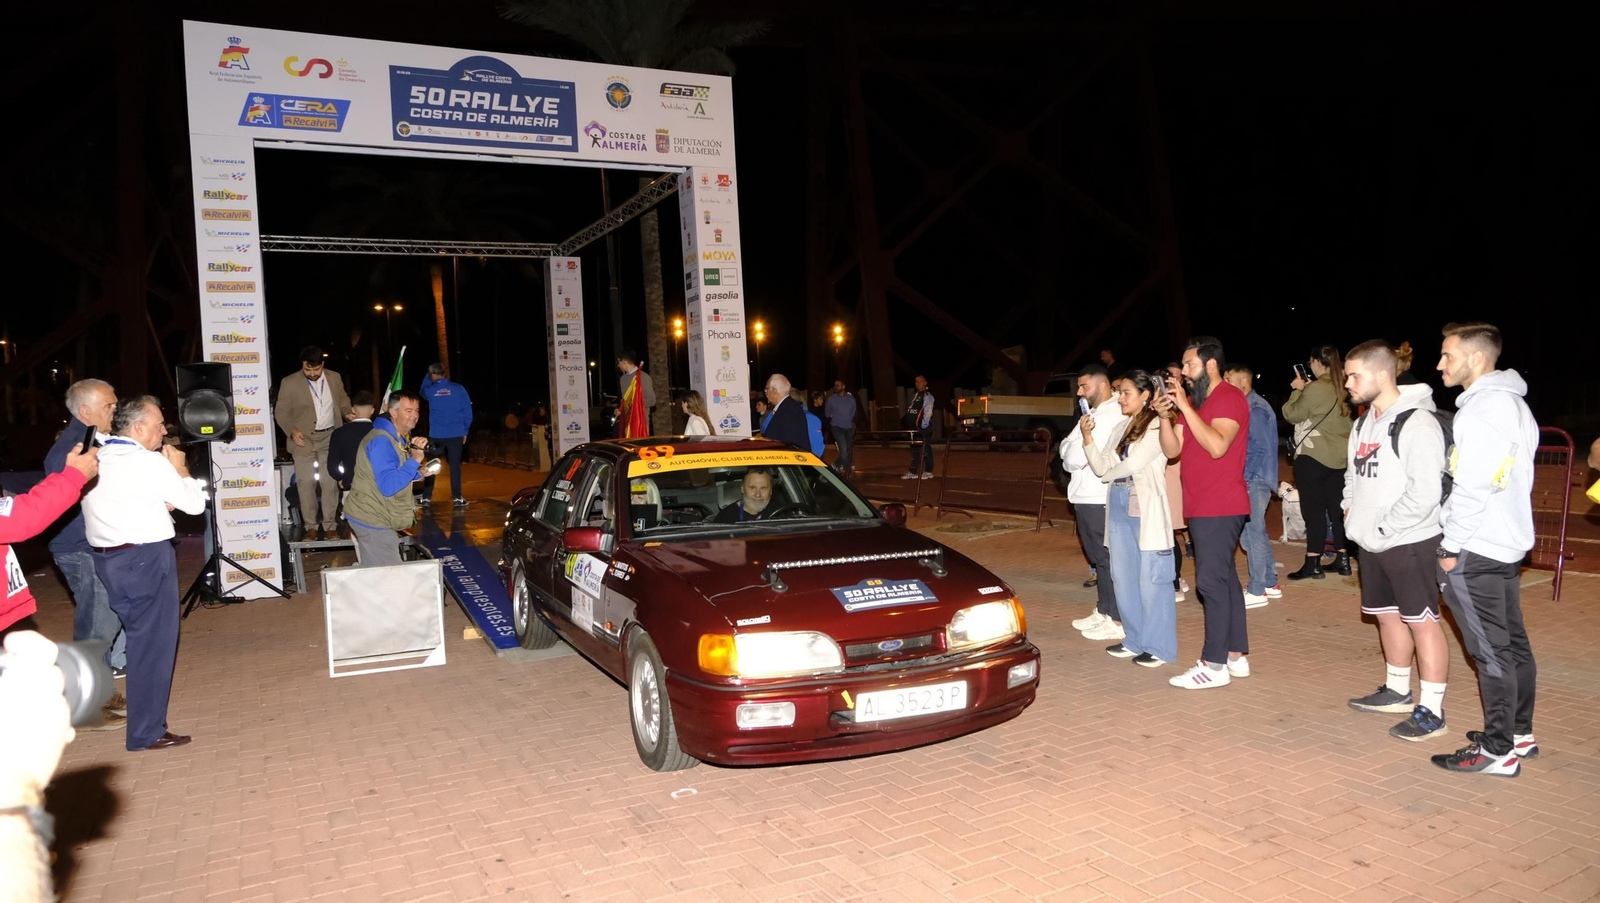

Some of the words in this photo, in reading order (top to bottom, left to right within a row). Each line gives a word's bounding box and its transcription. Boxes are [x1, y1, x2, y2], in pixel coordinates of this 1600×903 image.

[410, 86, 445, 106] 50
[449, 89, 560, 114] RALLYE
[280, 99, 338, 114] CERA
[293, 118, 327, 127] Recalvi
[410, 108, 462, 121] COSTA
[466, 112, 487, 123] DE
[490, 113, 559, 128] ALMERÍA
[609, 132, 634, 140] COSTA
[602, 140, 647, 152] ALMERÍA
[674, 137, 722, 147] DIPUTACIÓN
[686, 146, 720, 156] ALMERÍA
[204, 190, 248, 200] Rallycar
[211, 211, 241, 219] Recalvi
[703, 250, 737, 260] MOYA
[208, 262, 252, 272] Rallycar
[706, 291, 739, 302] gasolia
[212, 334, 257, 343] Rallycar
[708, 330, 741, 339] Phonika
[638, 445, 675, 461] 69
[669, 456, 718, 466] AUTOMÓVIL
[222, 479, 267, 489] Rallycar
[231, 499, 260, 508] Recalvi
[844, 590, 862, 598] 50
[863, 584, 919, 596] RALLYE
[864, 697, 886, 716] AL
[896, 689, 944, 713] 3523
[951, 686, 960, 706] P
